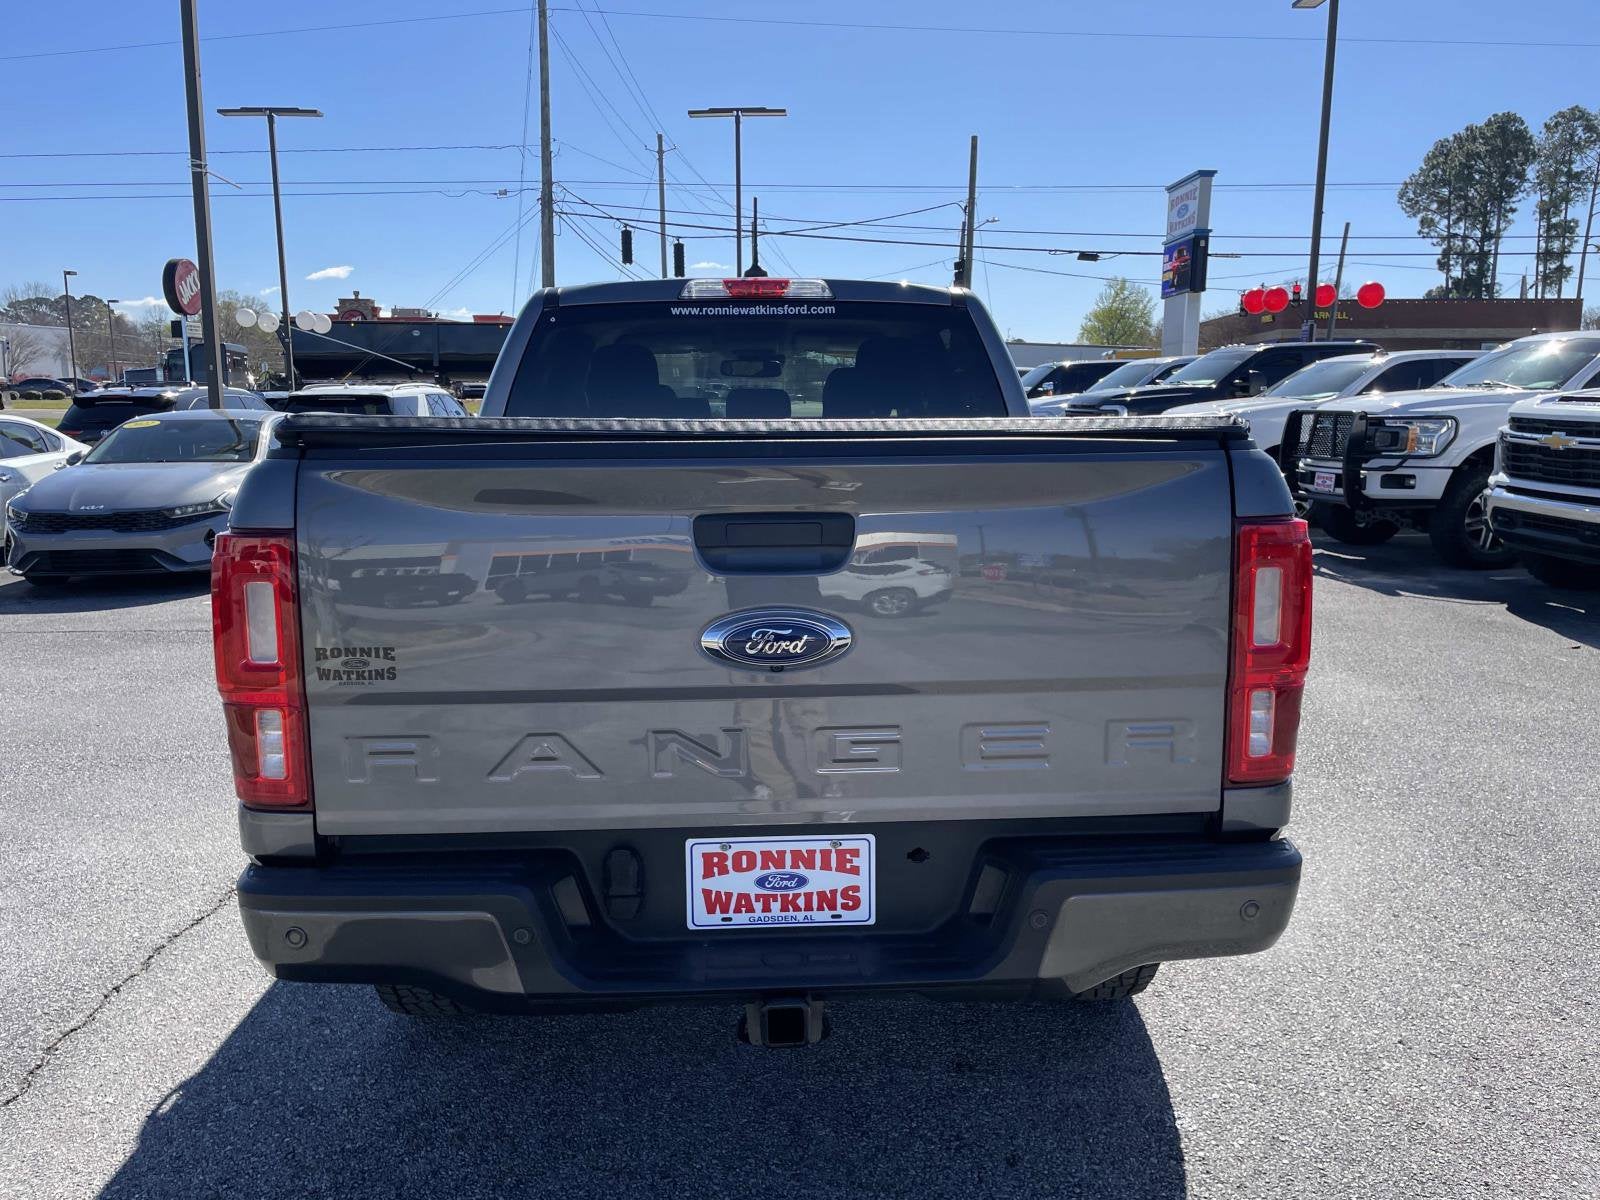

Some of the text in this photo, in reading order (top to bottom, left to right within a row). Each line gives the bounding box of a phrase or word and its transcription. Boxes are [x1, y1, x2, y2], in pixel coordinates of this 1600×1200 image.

[671, 304, 836, 315] www.ronniewatkinsford.com
[745, 628, 813, 655] Ford
[314, 646, 396, 662] RONNIE
[316, 666, 397, 681] WATKINS
[343, 716, 1200, 783] RANGER
[701, 848, 861, 880] RONNIE
[765, 874, 799, 889] Ford
[701, 884, 862, 915] WATKINS
[748, 914, 800, 923] GADSDEN,
